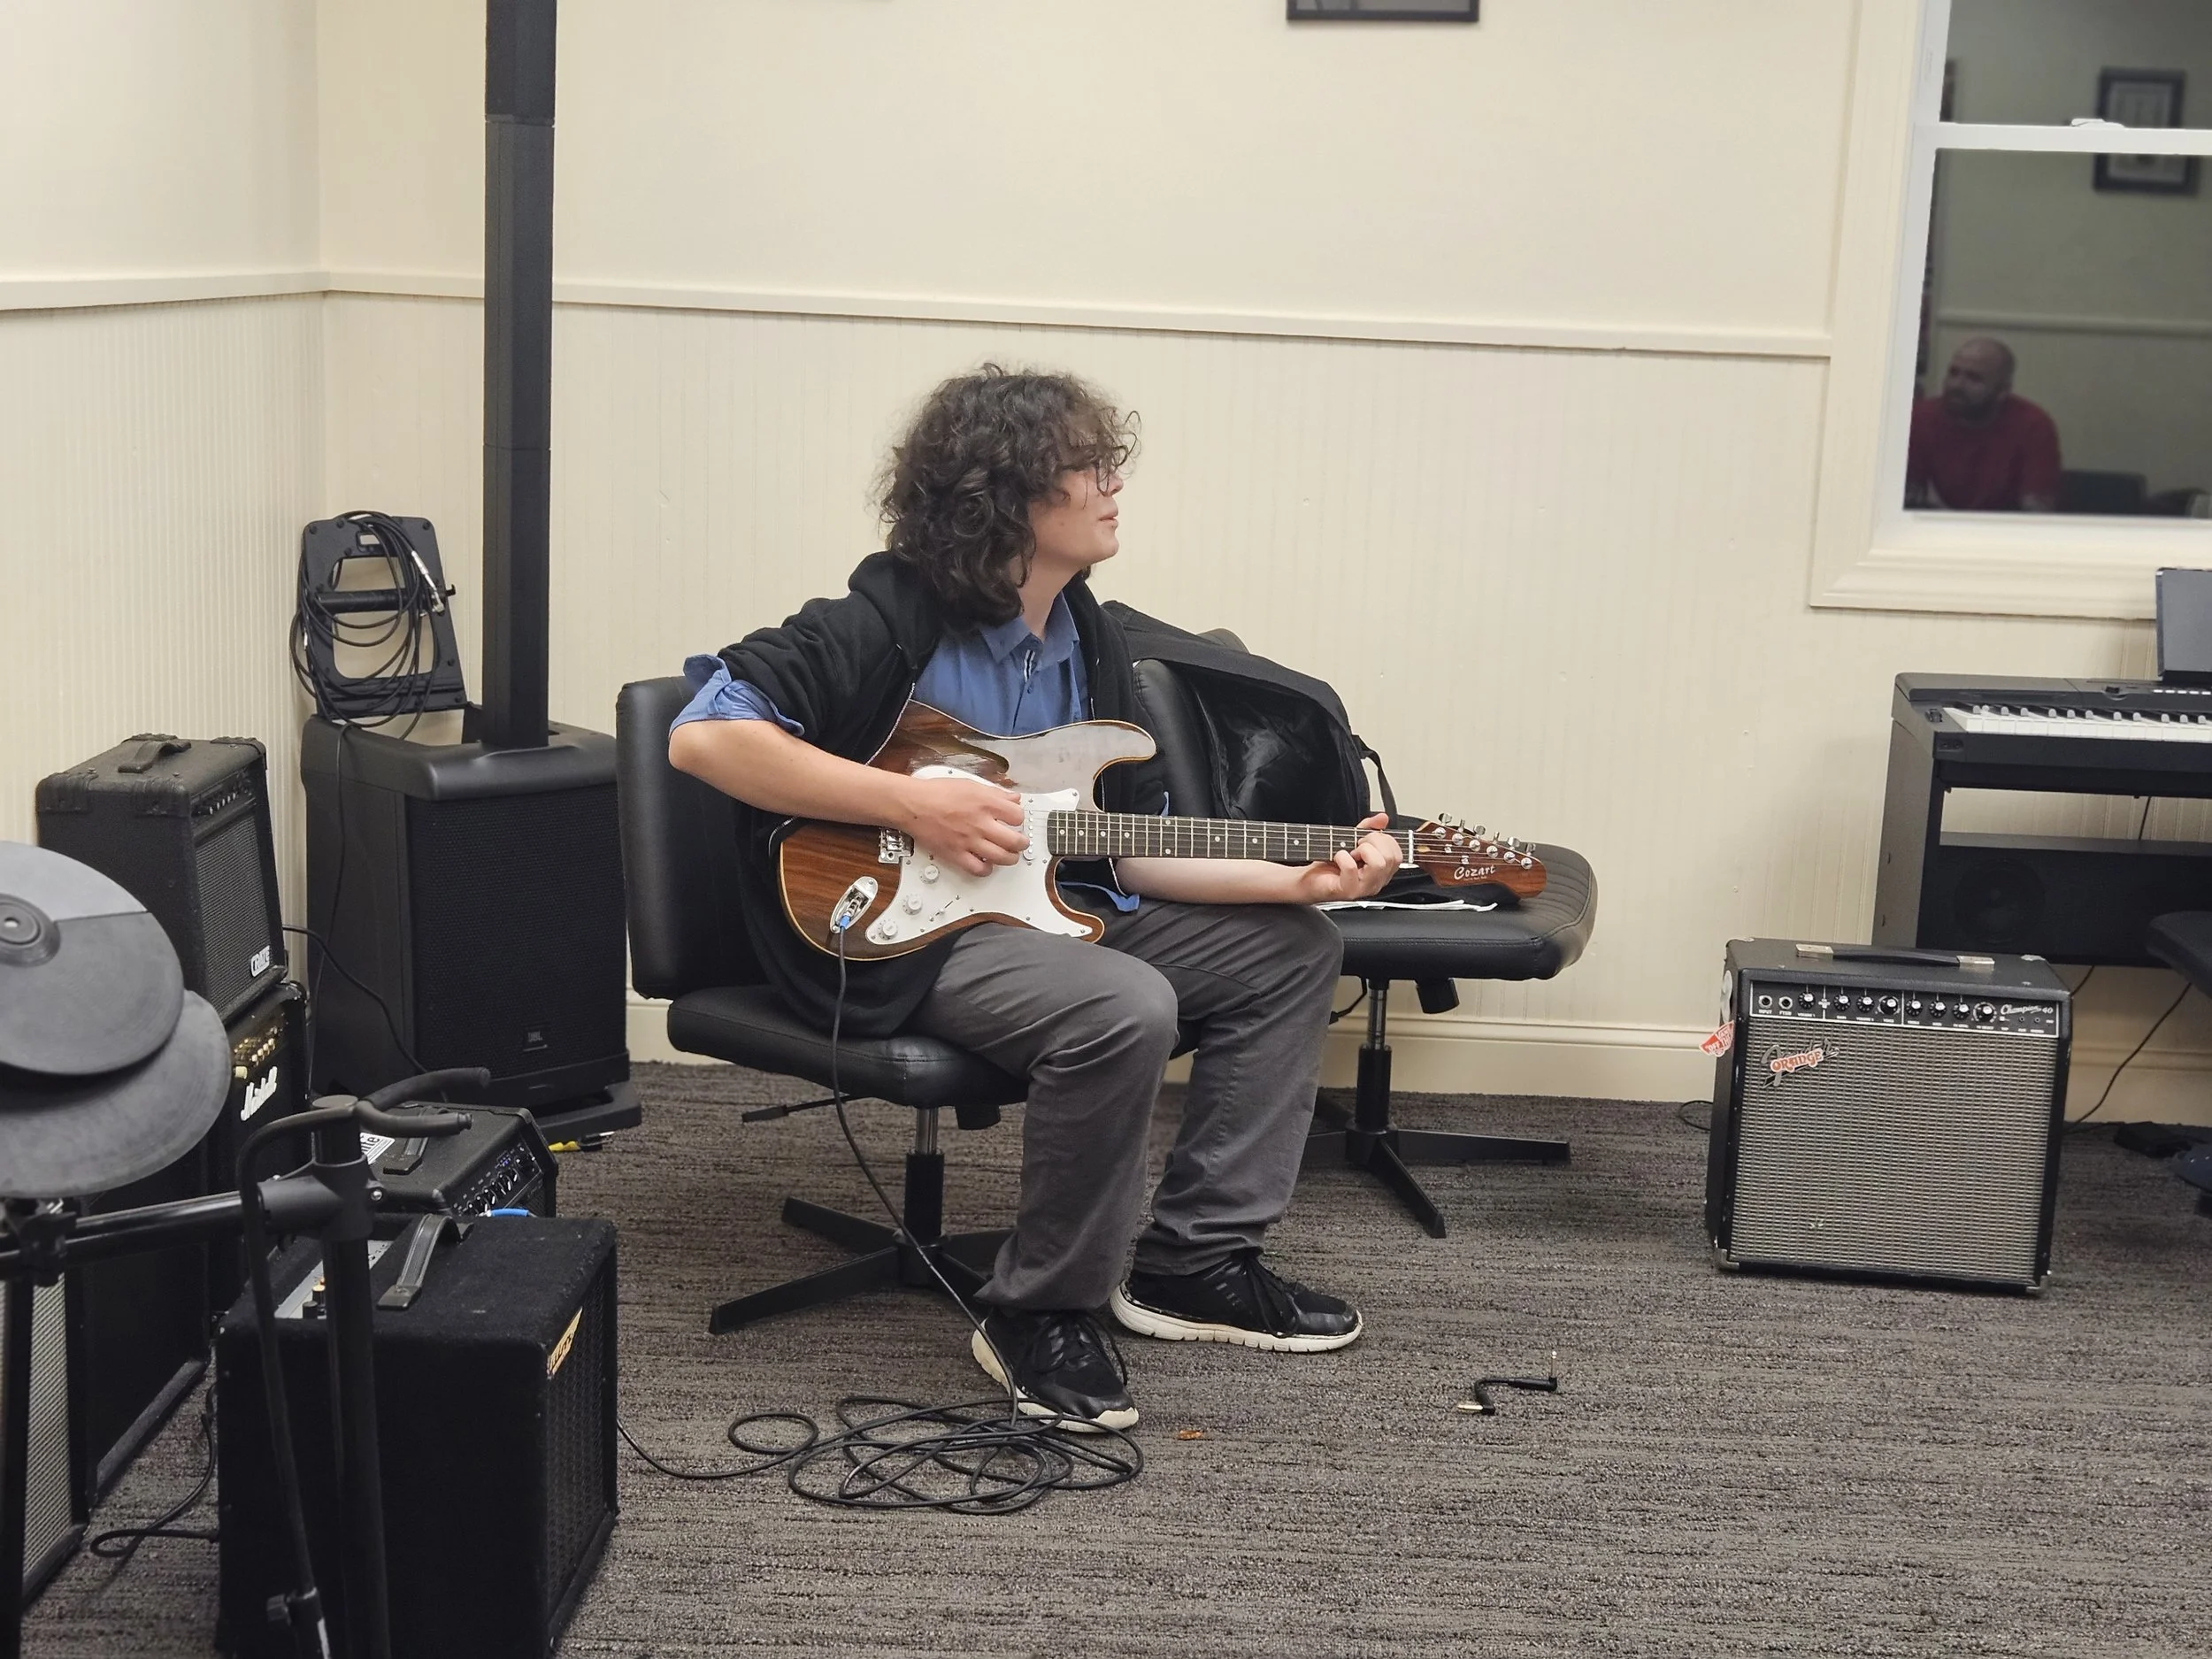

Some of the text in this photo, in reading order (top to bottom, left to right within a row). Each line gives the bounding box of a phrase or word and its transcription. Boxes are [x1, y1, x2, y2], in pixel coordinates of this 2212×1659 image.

[1454, 864, 1495, 879] Cozart
[2000, 1003, 2054, 1016] Champion 40
[1771, 1050, 1821, 1071] ORANGE
